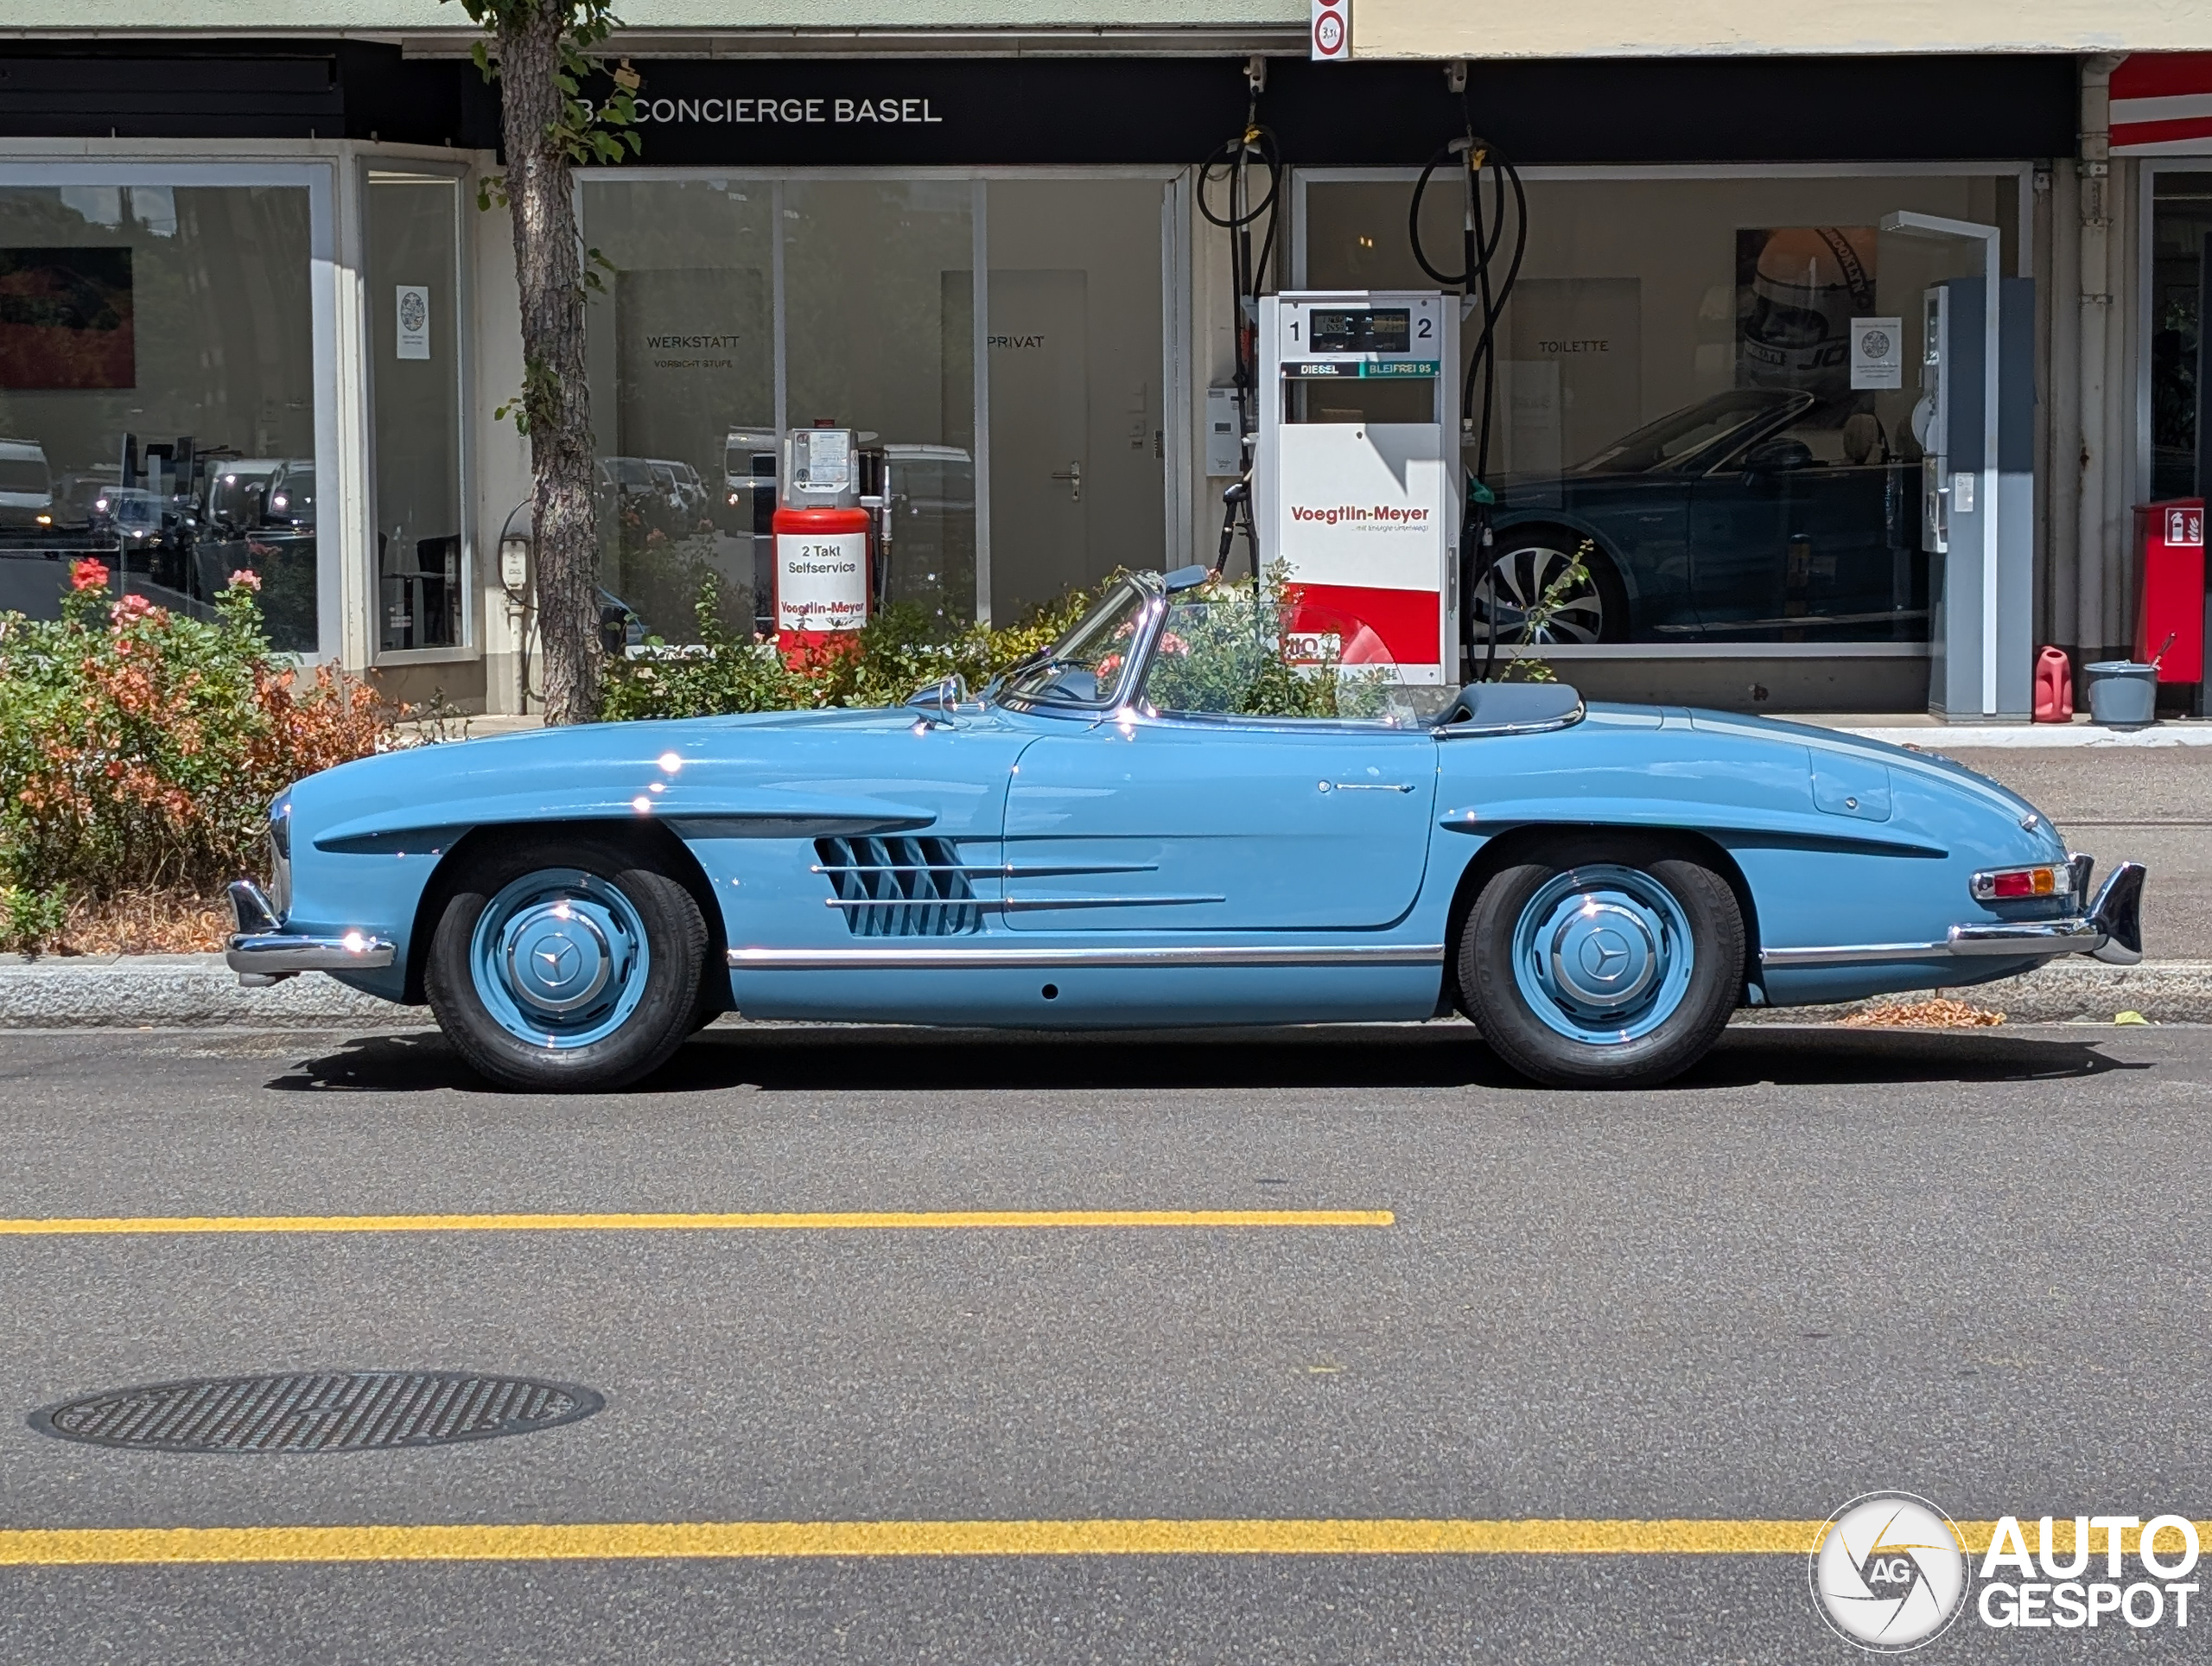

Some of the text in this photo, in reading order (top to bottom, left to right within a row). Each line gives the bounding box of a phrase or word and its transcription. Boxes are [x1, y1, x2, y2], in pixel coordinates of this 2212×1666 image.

[632, 99, 826, 123] CONCIERGE
[835, 99, 943, 123] BASEL
[1290, 321, 1300, 341] 1
[1417, 318, 1432, 338] 2
[646, 334, 740, 348] WERKSTATT
[987, 335, 1045, 348] PRIVAT
[1538, 340, 1609, 353] TOILETTE
[1300, 365, 1339, 374] DIESEL
[1369, 364, 1417, 374] BLEIFREI
[1291, 506, 1429, 525] Voegtlin-Meyer
[802, 545, 841, 557] 2 Takt
[788, 561, 856, 575] Selfservice
